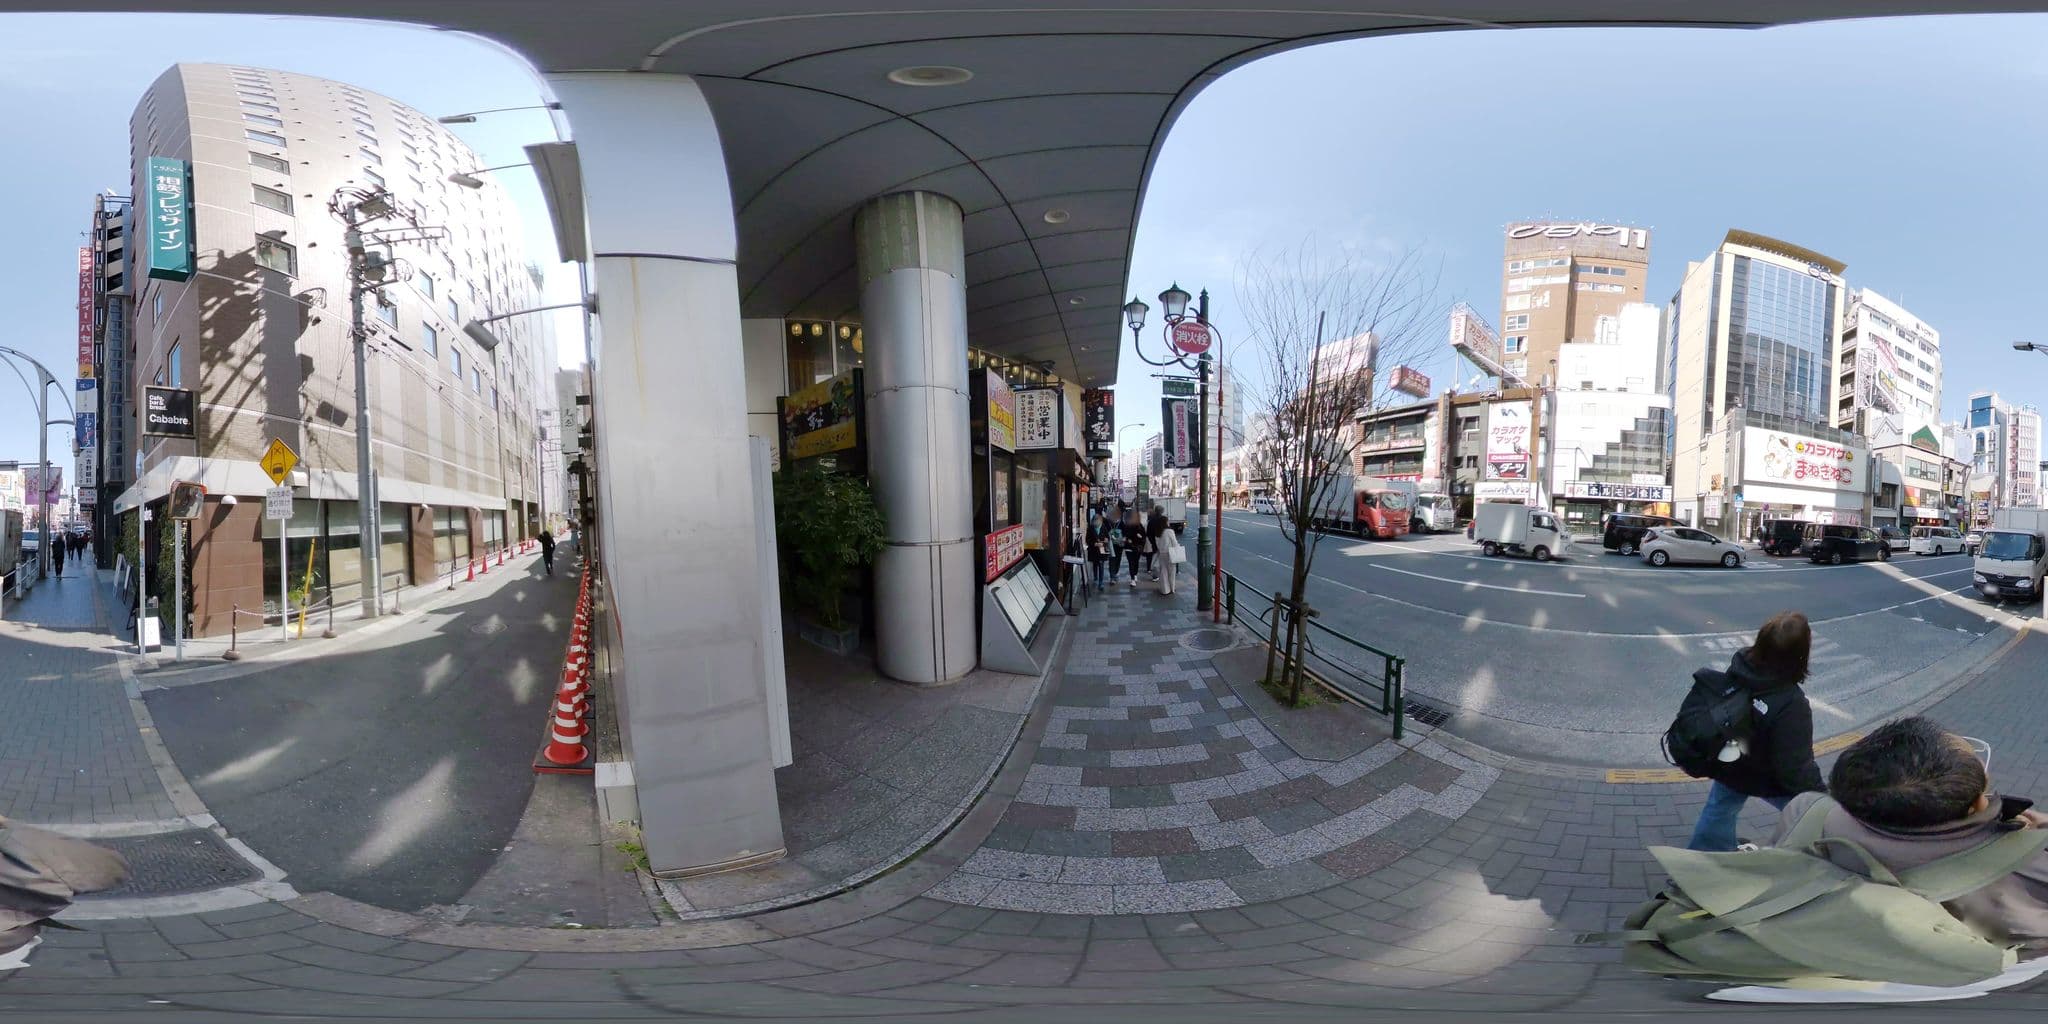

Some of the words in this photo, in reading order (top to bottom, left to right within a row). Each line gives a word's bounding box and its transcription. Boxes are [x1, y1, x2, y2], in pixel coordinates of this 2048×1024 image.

[1176, 330, 1208, 346] 消火栓
[1491, 425, 1528, 435] カラオケ
[1496, 435, 1521, 445] マック
[1805, 442, 1846, 460] カラオケ
[1795, 459, 1852, 483] まねきねこ
